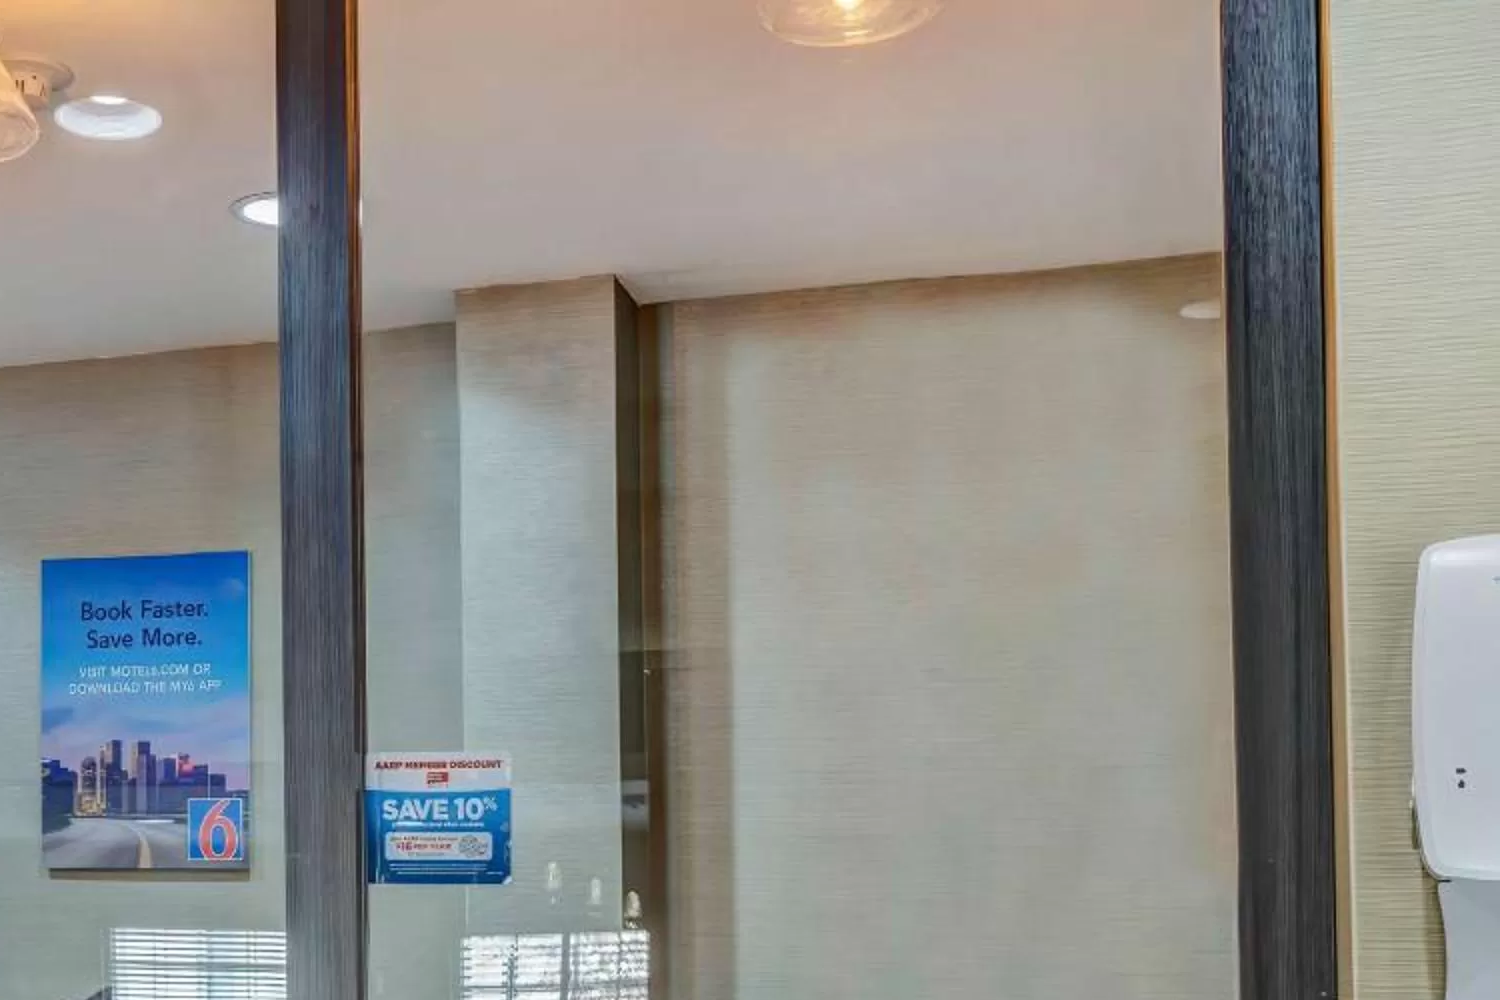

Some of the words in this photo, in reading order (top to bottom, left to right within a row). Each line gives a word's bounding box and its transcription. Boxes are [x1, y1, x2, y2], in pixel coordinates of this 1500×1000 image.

[80, 600, 133, 621] Book
[140, 600, 209, 620] Faster.
[86, 629, 133, 649] Save
[141, 628, 203, 647] More.
[79, 666, 106, 678] VISIT
[192, 663, 211, 676] OR
[68, 682, 140, 695] DOWNLOAD
[143, 681, 165, 693] THE
[199, 679, 223, 690] APP
[449, 760, 502, 769] DISCOUNT
[382, 797, 449, 821] SAVE
[453, 795, 499, 821] 10%
[197, 799, 239, 861] 6
